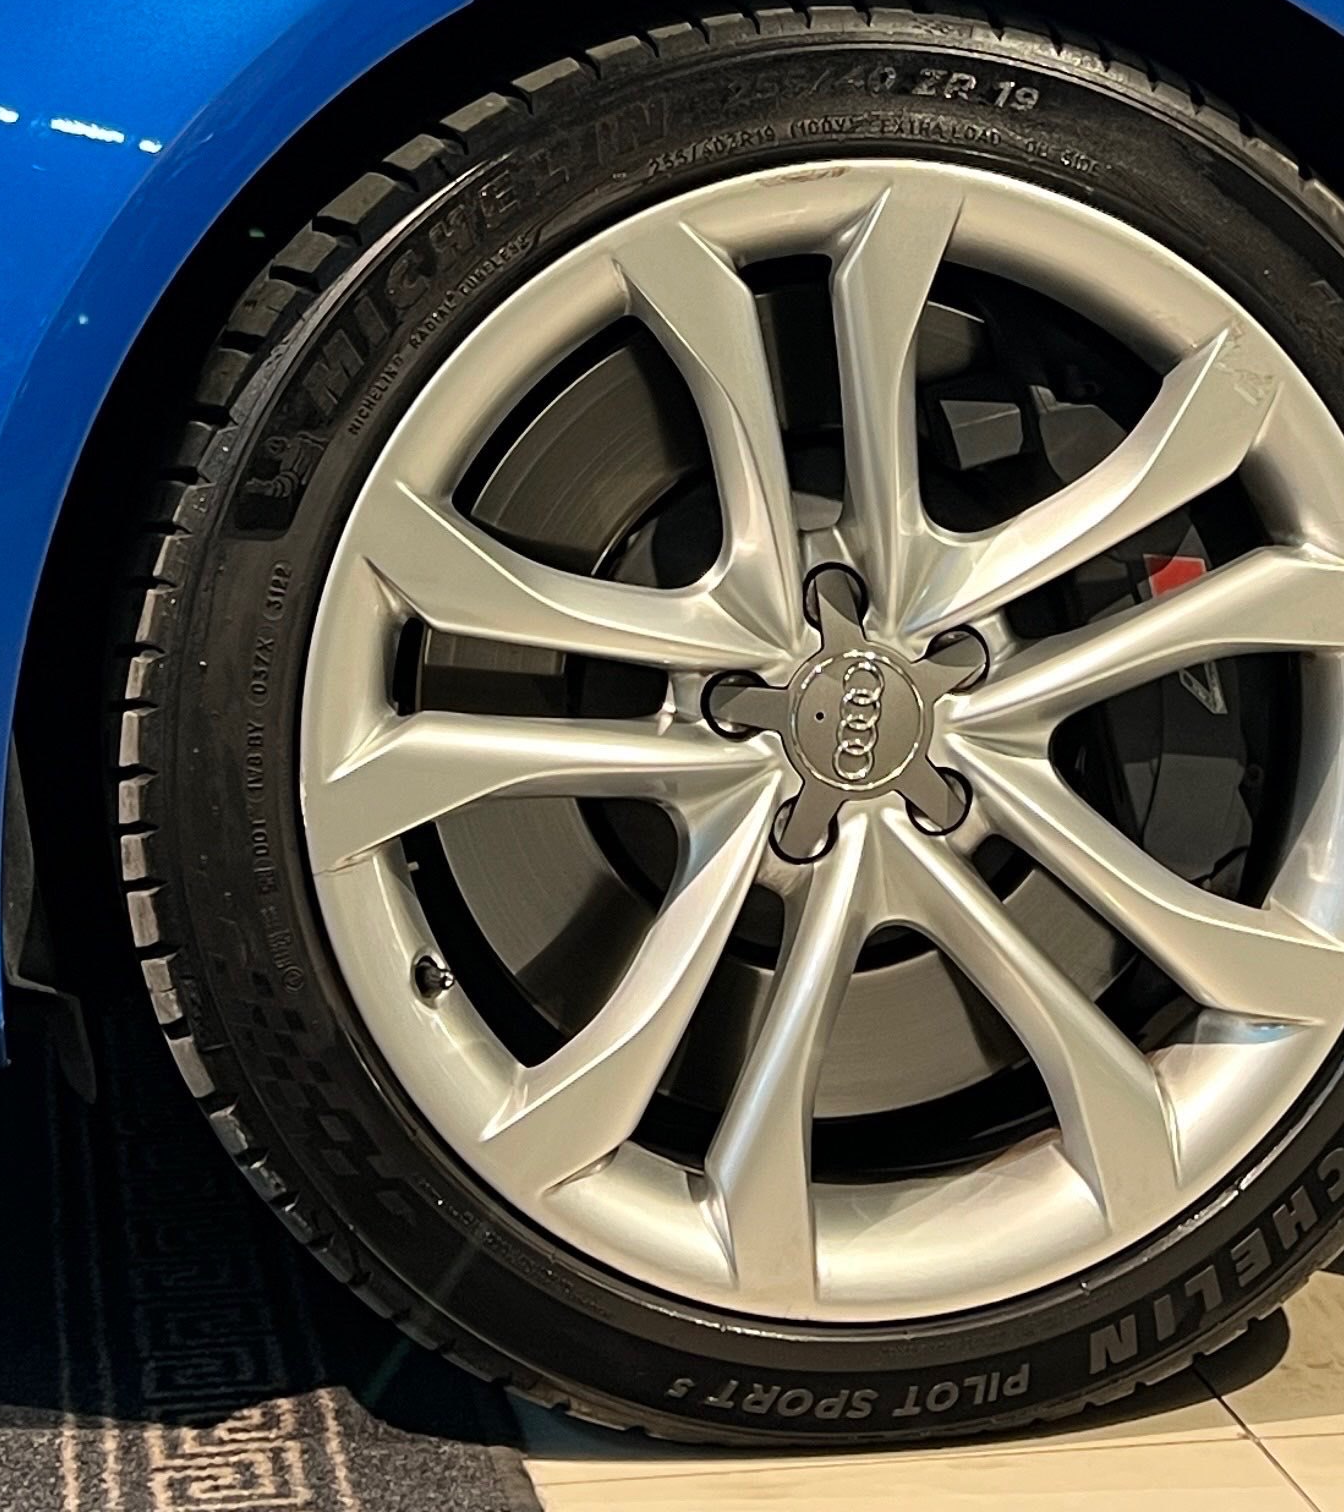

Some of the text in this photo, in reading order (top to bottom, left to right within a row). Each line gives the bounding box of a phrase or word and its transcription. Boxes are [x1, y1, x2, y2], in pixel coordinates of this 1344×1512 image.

[912, 67, 977, 100] ZR
[993, 76, 1040, 112] 19
[296, 91, 673, 419] MICHELIN
[664, 1361, 1032, 1423] PILOT SPORT 5
